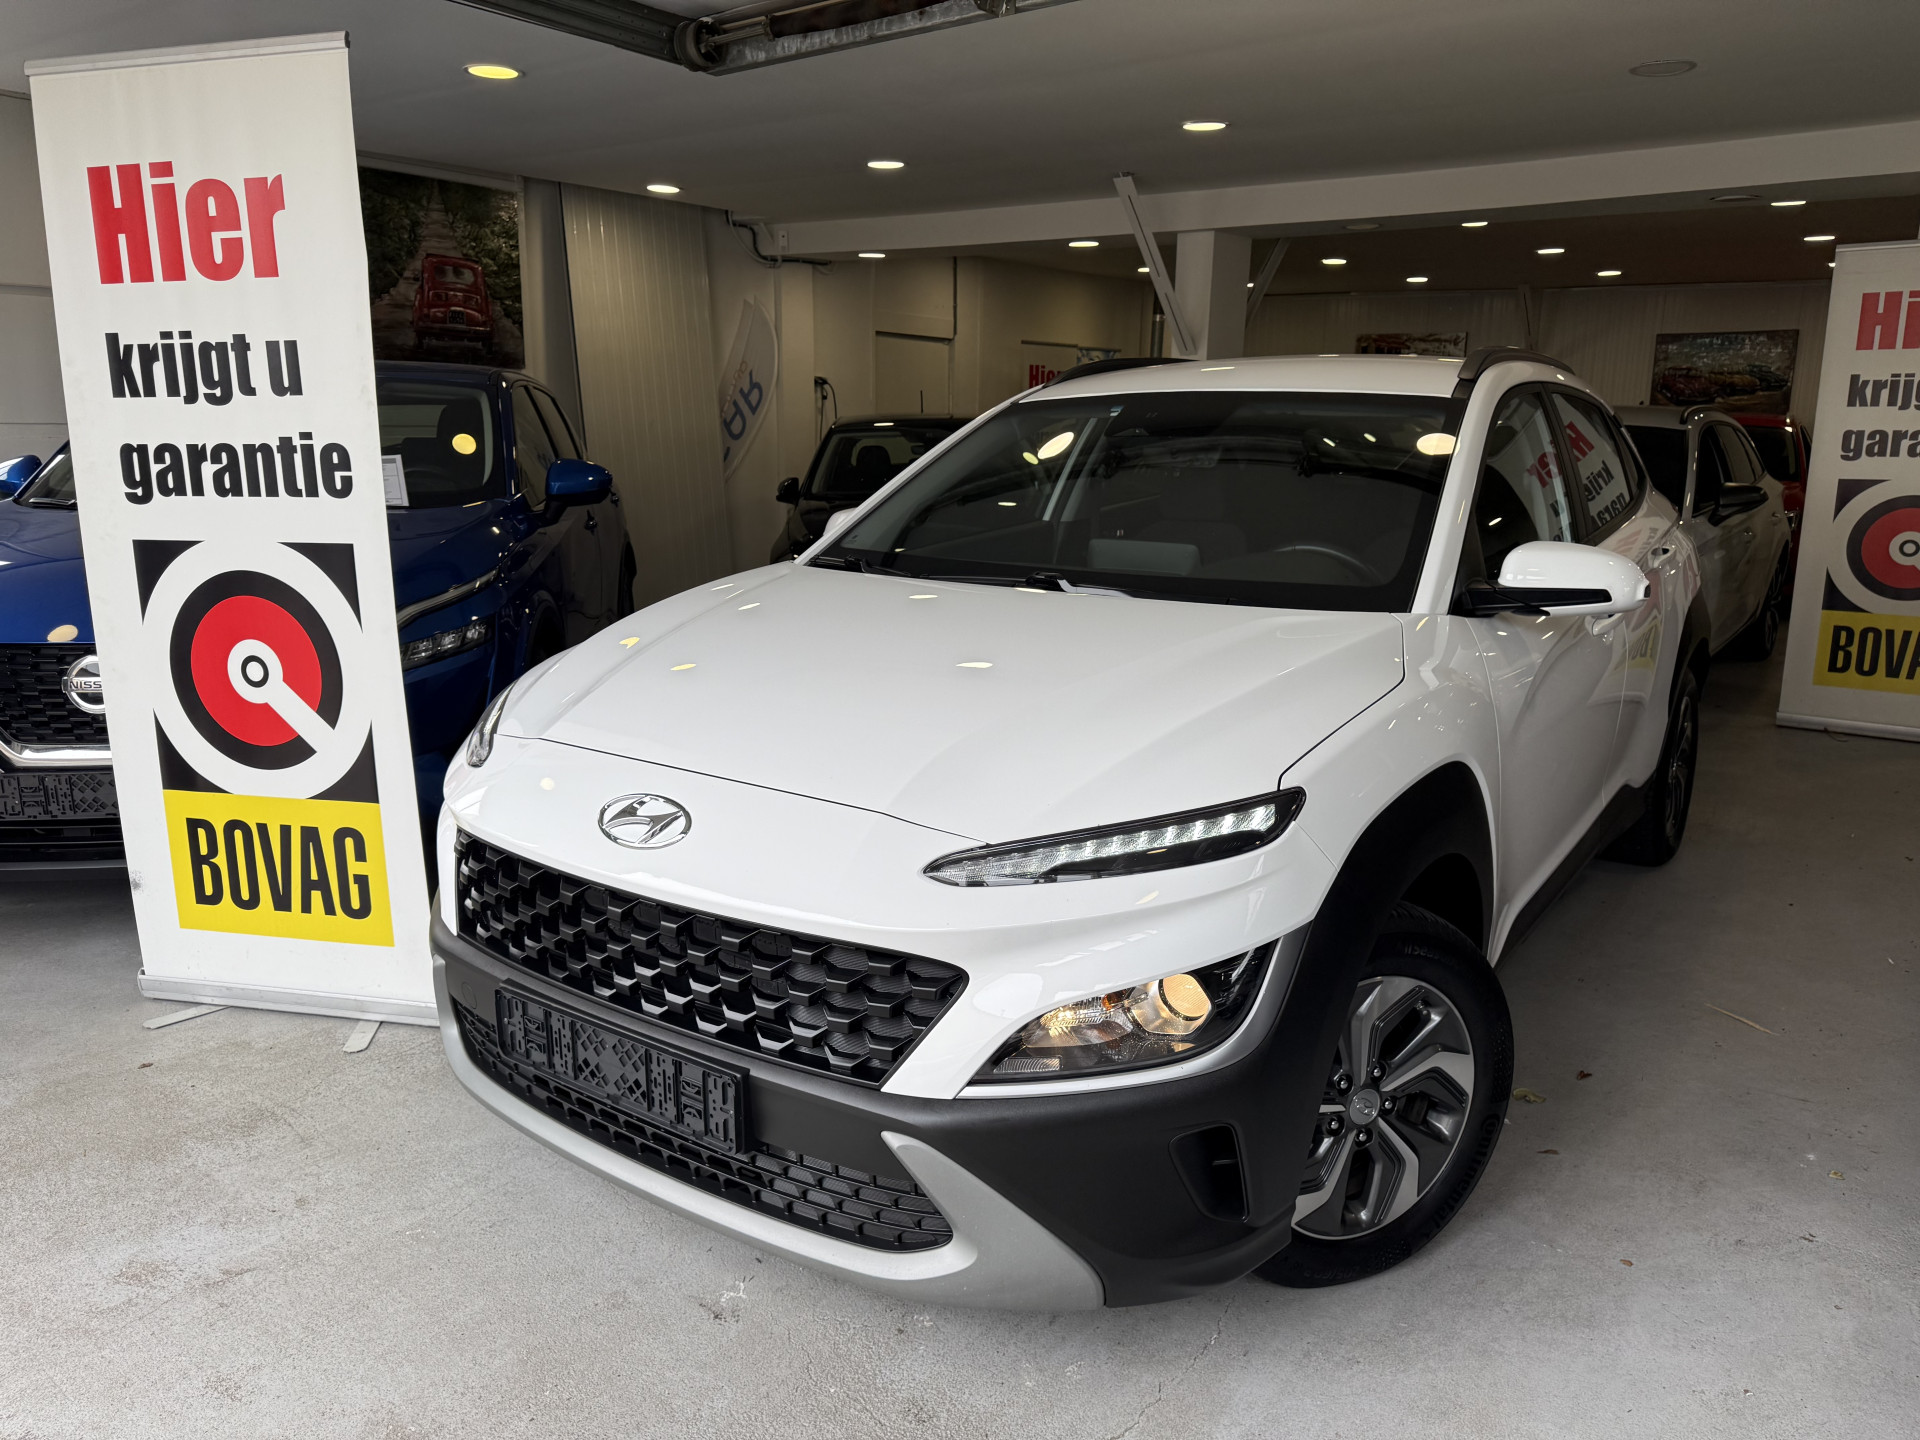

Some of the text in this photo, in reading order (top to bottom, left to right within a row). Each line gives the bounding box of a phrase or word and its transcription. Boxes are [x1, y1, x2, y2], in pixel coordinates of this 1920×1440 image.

[87, 161, 286, 284] Hier
[105, 331, 303, 406] krijgt u
[1029, 364, 1063, 389] Hie
[119, 432, 353, 505] garantie
[186, 817, 372, 920] BOVAG
